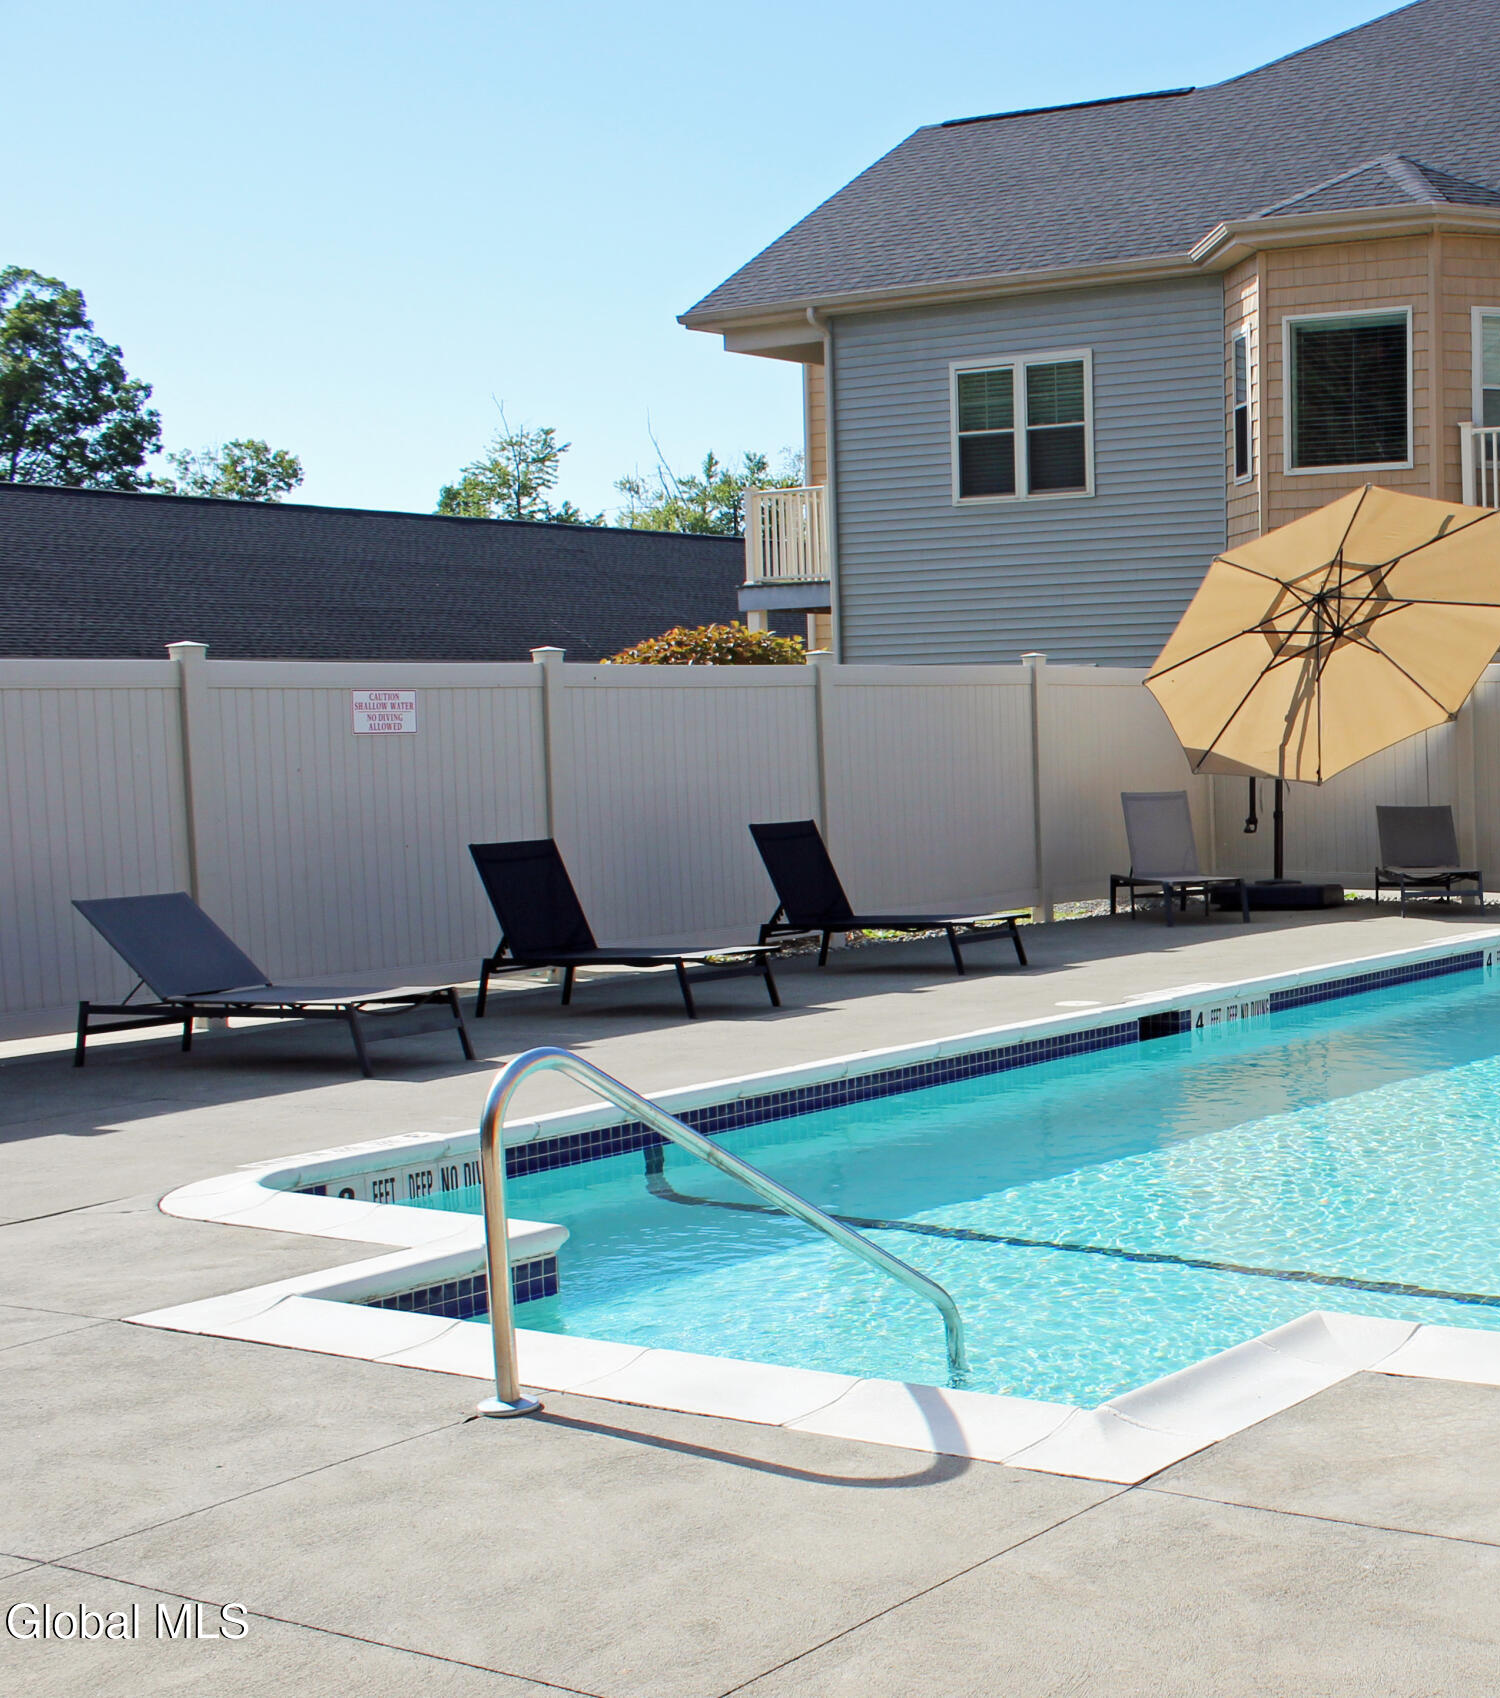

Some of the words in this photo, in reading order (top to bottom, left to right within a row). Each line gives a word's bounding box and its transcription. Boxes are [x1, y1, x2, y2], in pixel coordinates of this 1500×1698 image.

[369, 693, 400, 701] CAUTION
[354, 702, 387, 710] SHALLOW
[390, 702, 414, 710] WATER
[367, 714, 377, 722] NO
[378, 714, 403, 722] DIVING
[368, 722, 403, 731] ALLOWED
[1196, 1011, 1204, 1028] 4
[441, 1165, 459, 1192] NO
